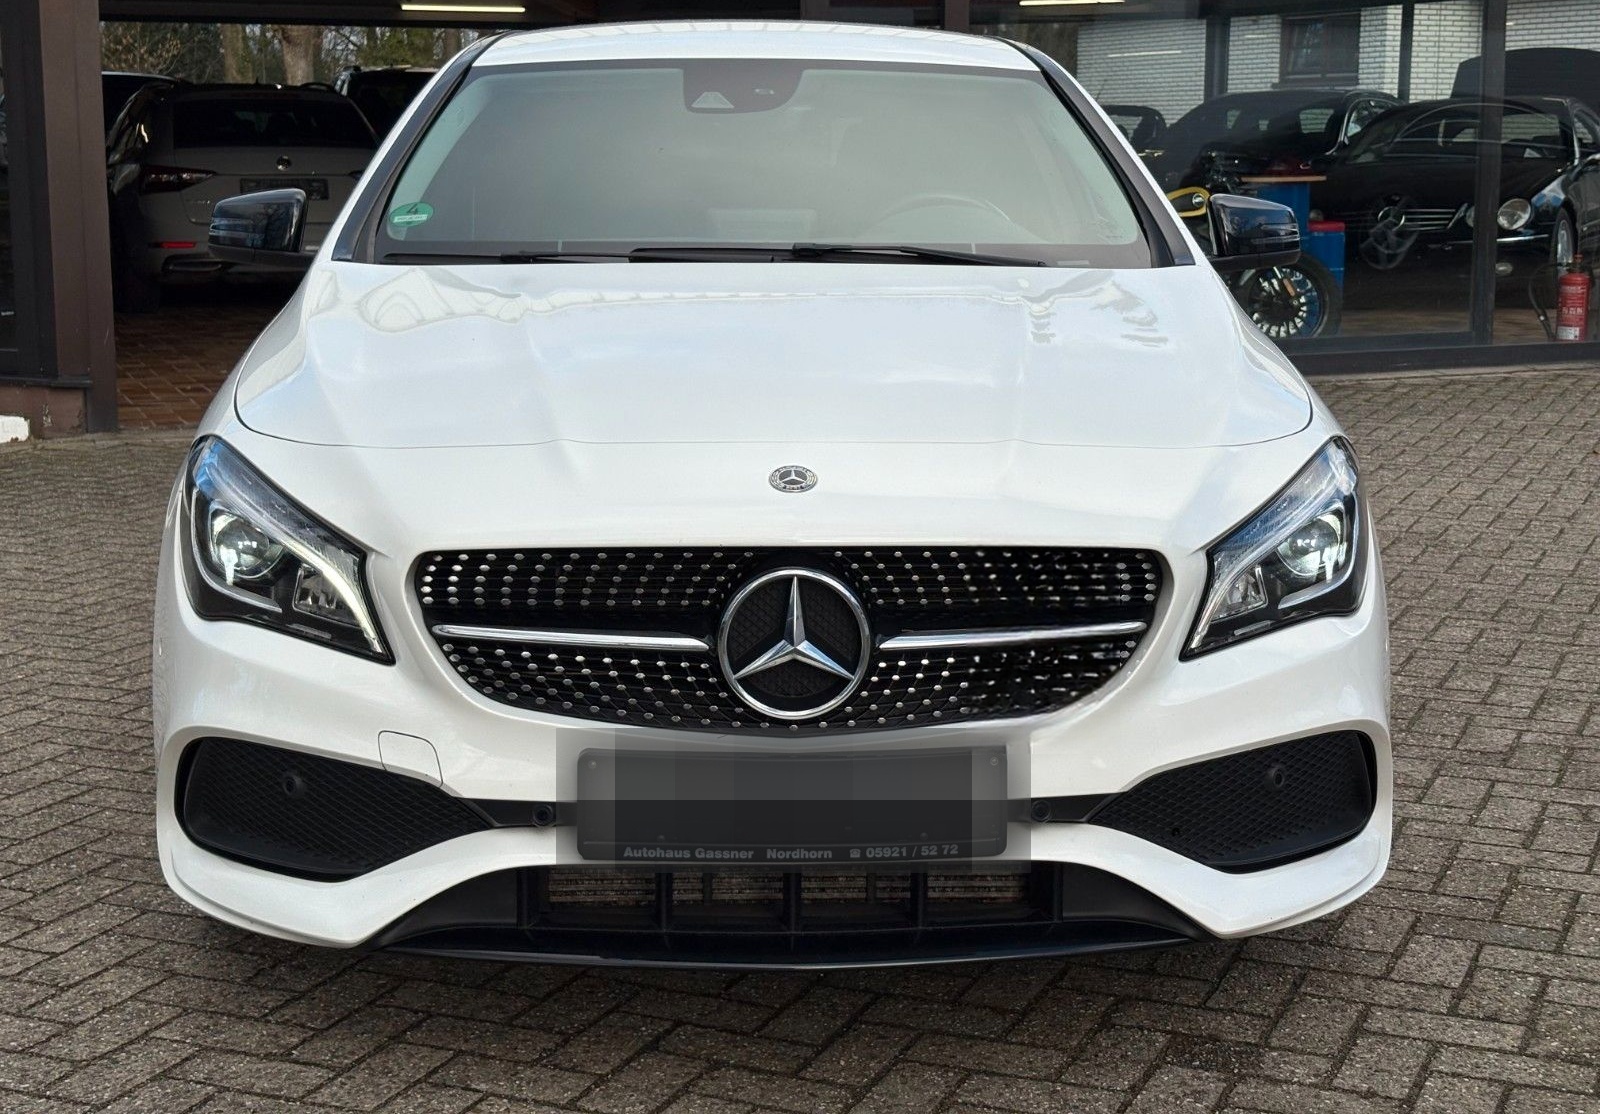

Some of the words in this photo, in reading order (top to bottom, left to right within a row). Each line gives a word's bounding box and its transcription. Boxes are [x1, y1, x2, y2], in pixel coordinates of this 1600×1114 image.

[623, 847, 691, 858] Autohaus
[695, 848, 754, 859] Gassner
[766, 848, 833, 859] Nordhorn
[865, 846, 908, 858] 05921
[911, 846, 918, 857] /
[921, 845, 938, 856] 52
[942, 844, 959, 855] 72
